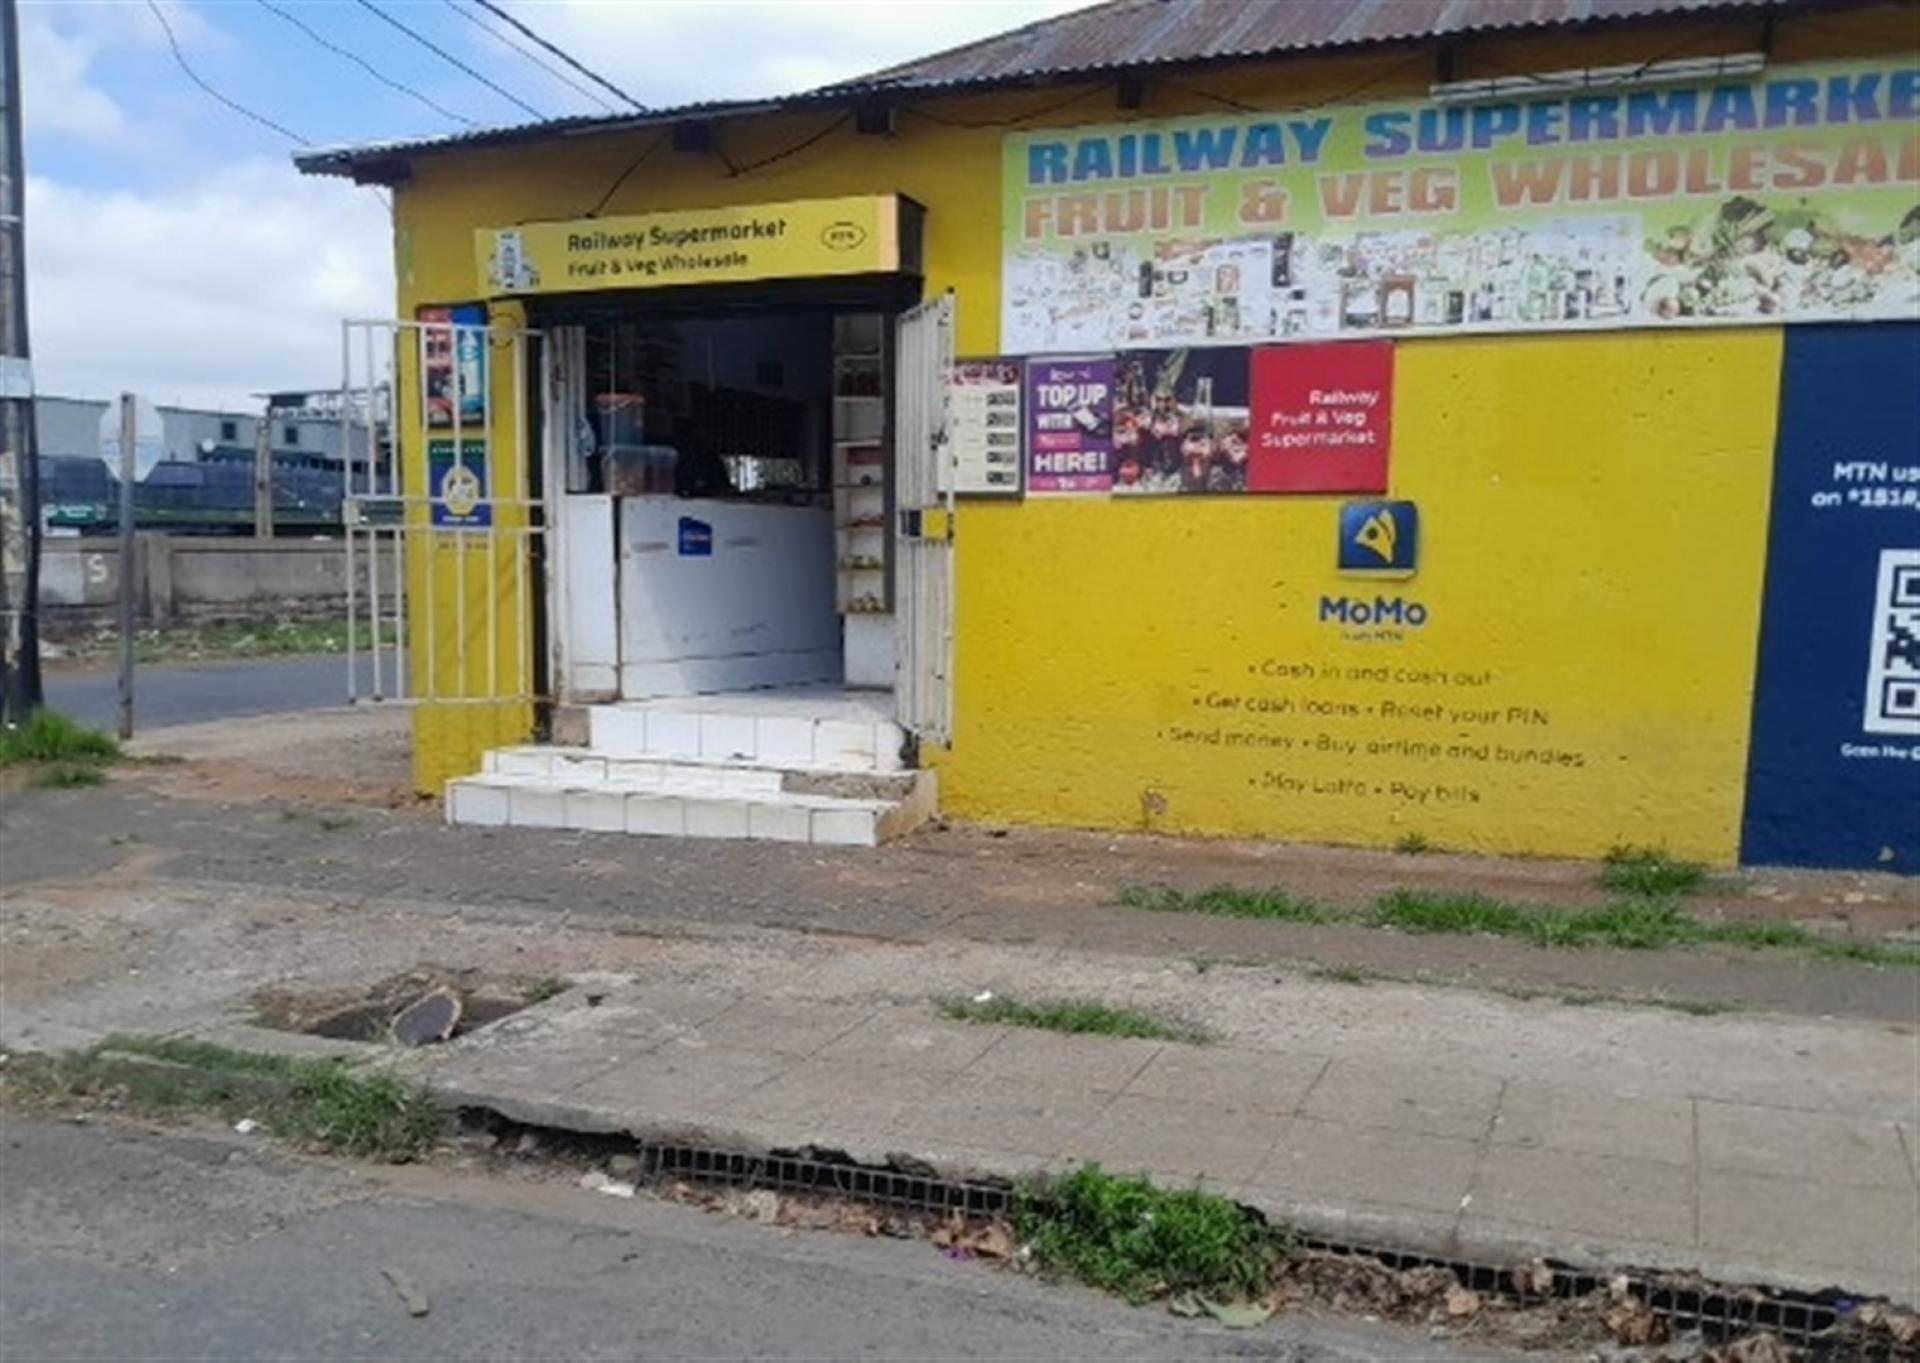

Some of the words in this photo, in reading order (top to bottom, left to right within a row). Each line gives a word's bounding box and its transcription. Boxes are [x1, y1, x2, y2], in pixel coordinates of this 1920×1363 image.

[1028, 117, 1333, 184] RAILWAY
[1023, 184, 1210, 239] FRUIT
[1239, 180, 1288, 224] &
[1319, 167, 1457, 217] VEG
[567, 231, 645, 252] Railway
[650, 217, 787, 247] Supermarket
[567, 261, 607, 277] Fruit
[609, 261, 622, 275] &
[626, 257, 657, 276] Veg
[660, 251, 748, 271] Wholesale
[1037, 383, 1077, 407] TOP
[1079, 383, 1107, 405] UP
[1308, 389, 1380, 408] Railway
[1331, 409, 1367, 428] Veg
[1261, 430, 1377, 448] Supermarket
[1034, 451, 1107, 473] HERE!
[1833, 460, 1888, 482] MTN
[1811, 491, 1842, 507] on
[1319, 593, 1427, 625] MoMo
[1260, 658, 1315, 679] Cash
[1322, 663, 1341, 679] in
[1346, 664, 1389, 682] and
[1393, 667, 1448, 685] cash
[1453, 670, 1491, 687] out
[1205, 691, 1241, 709] Get
[1450, 707, 1501, 724] your
[1506, 706, 1549, 726] PIN
[1169, 726, 1222, 746] Send
[1224, 730, 1297, 749] money
[1316, 732, 1357, 755] Buy
[1366, 738, 1441, 757] airtime
[1447, 743, 1490, 761] and
[1495, 746, 1585, 768] bundles
[1390, 781, 1431, 804] Pay
[1435, 784, 1480, 802] bills
